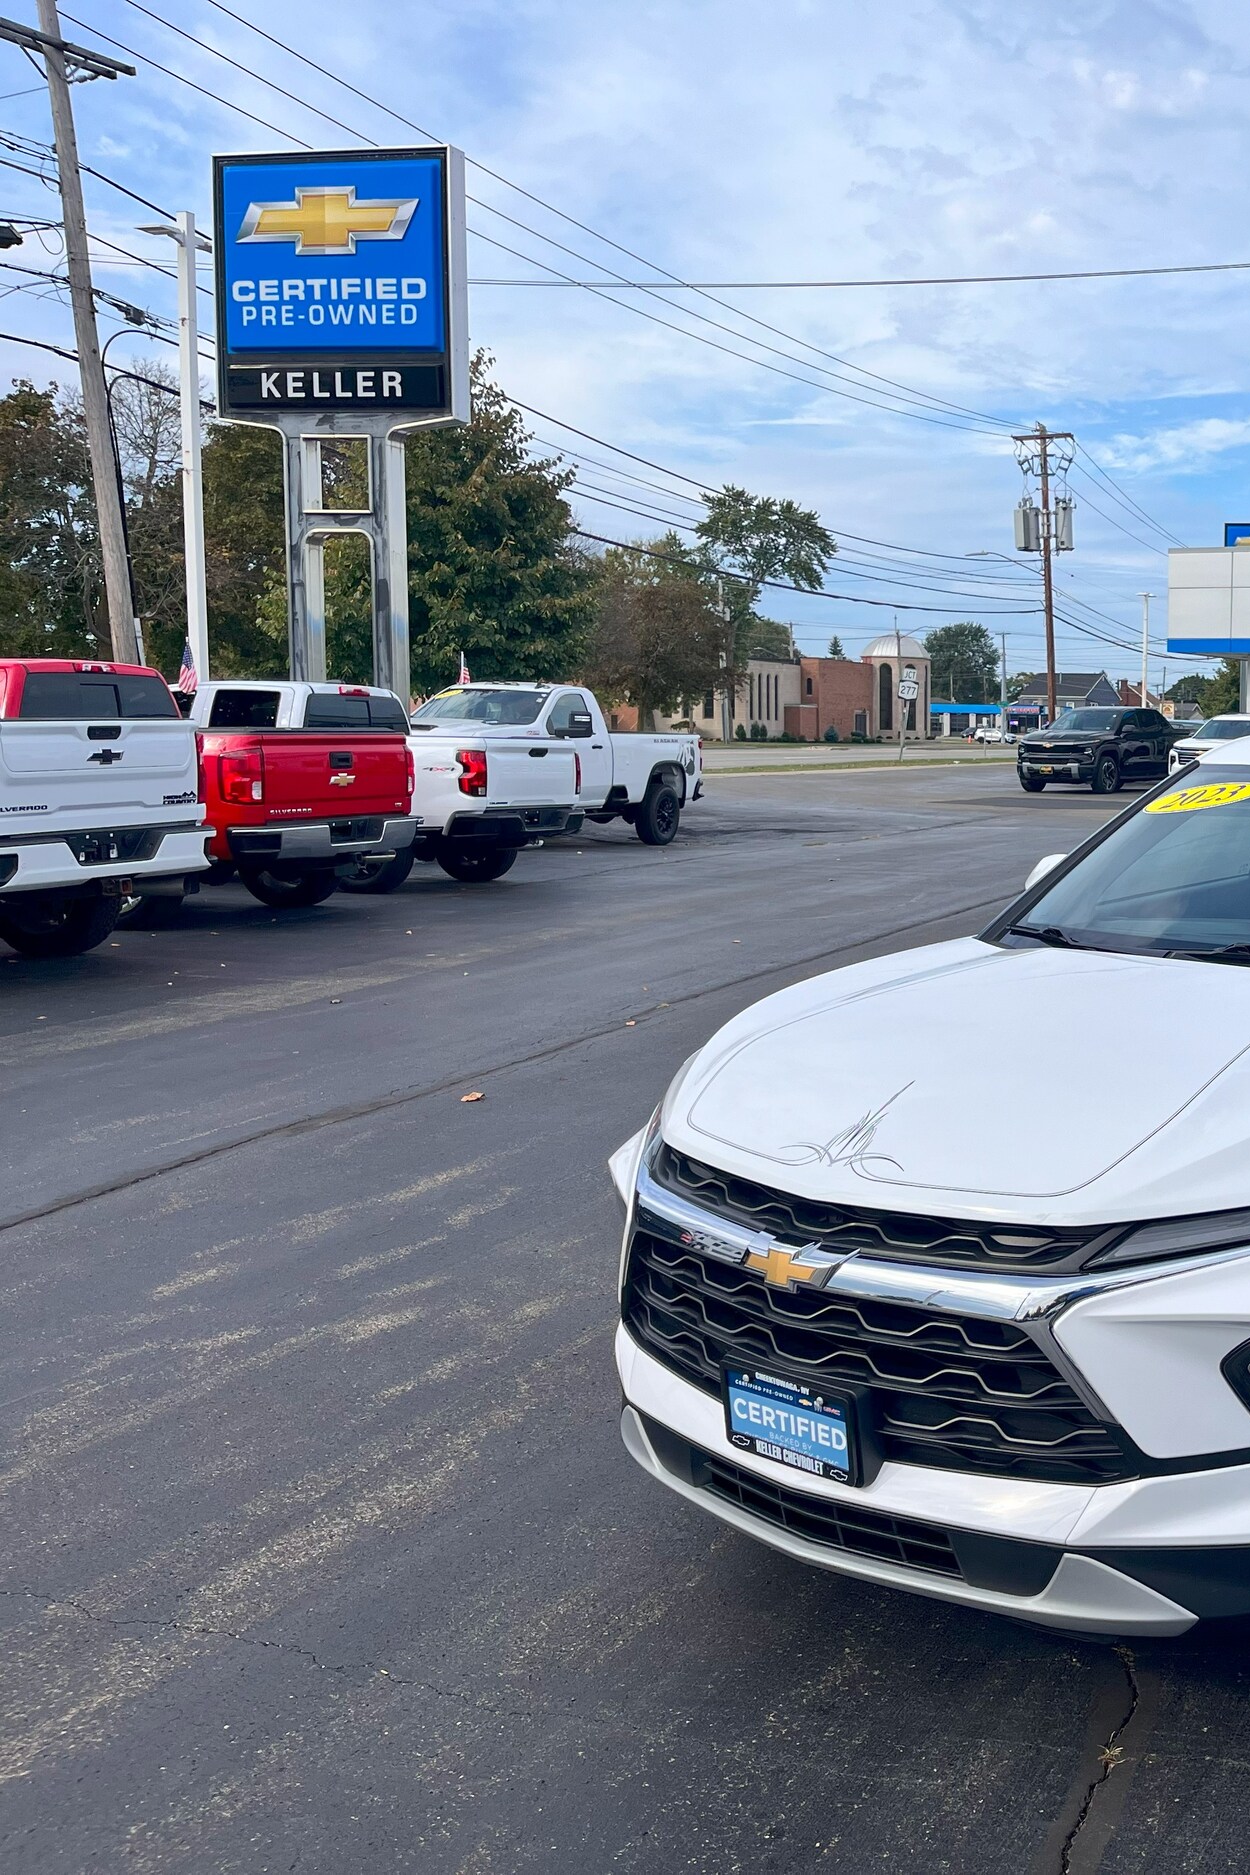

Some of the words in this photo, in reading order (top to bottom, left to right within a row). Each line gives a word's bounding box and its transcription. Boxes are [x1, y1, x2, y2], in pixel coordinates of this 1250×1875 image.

[231, 277, 427, 302] CERTIFIED
[242, 304, 418, 326] PRE-OWNED
[261, 371, 403, 398] KELLER
[904, 670, 916, 680] JCT
[900, 685, 917, 696] 277
[1158, 784, 1248, 811] 2023
[270, 807, 313, 815] SILVERADO
[734, 1379, 763, 1392] CERTIFIED
[800, 1385, 810, 1396] NY
[733, 1397, 847, 1451] CERTIFIED
[769, 1431, 800, 1447] BACKED
[802, 1441, 812, 1451] BY
[755, 1439, 782, 1461] KELLER
[783, 1448, 824, 1475] CHEVROLET
